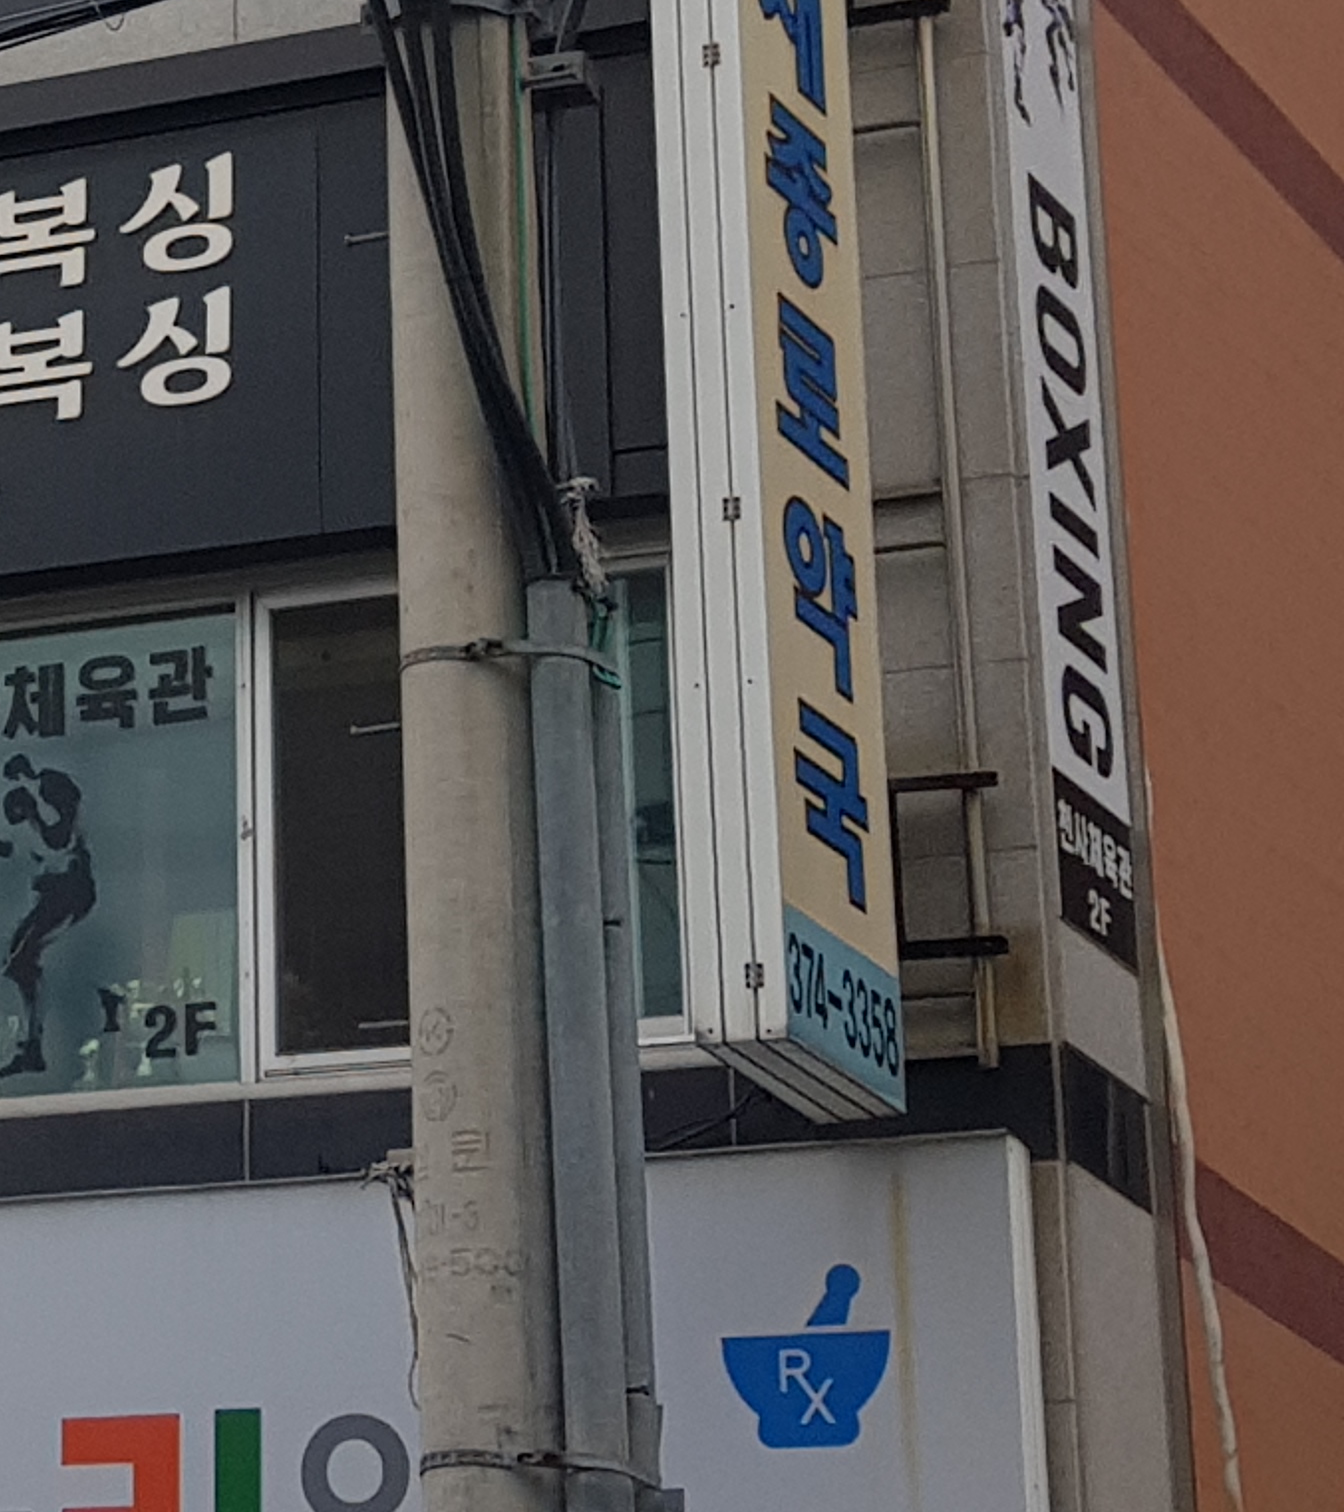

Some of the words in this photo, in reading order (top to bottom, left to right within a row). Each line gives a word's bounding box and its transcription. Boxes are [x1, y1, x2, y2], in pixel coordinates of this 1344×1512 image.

[1027, 172, 1113, 779] BOXING
[1088, 887, 1112, 936] 2F
[144, 1001, 218, 1059] 2F
[787, 929, 902, 1080] 374-3358
